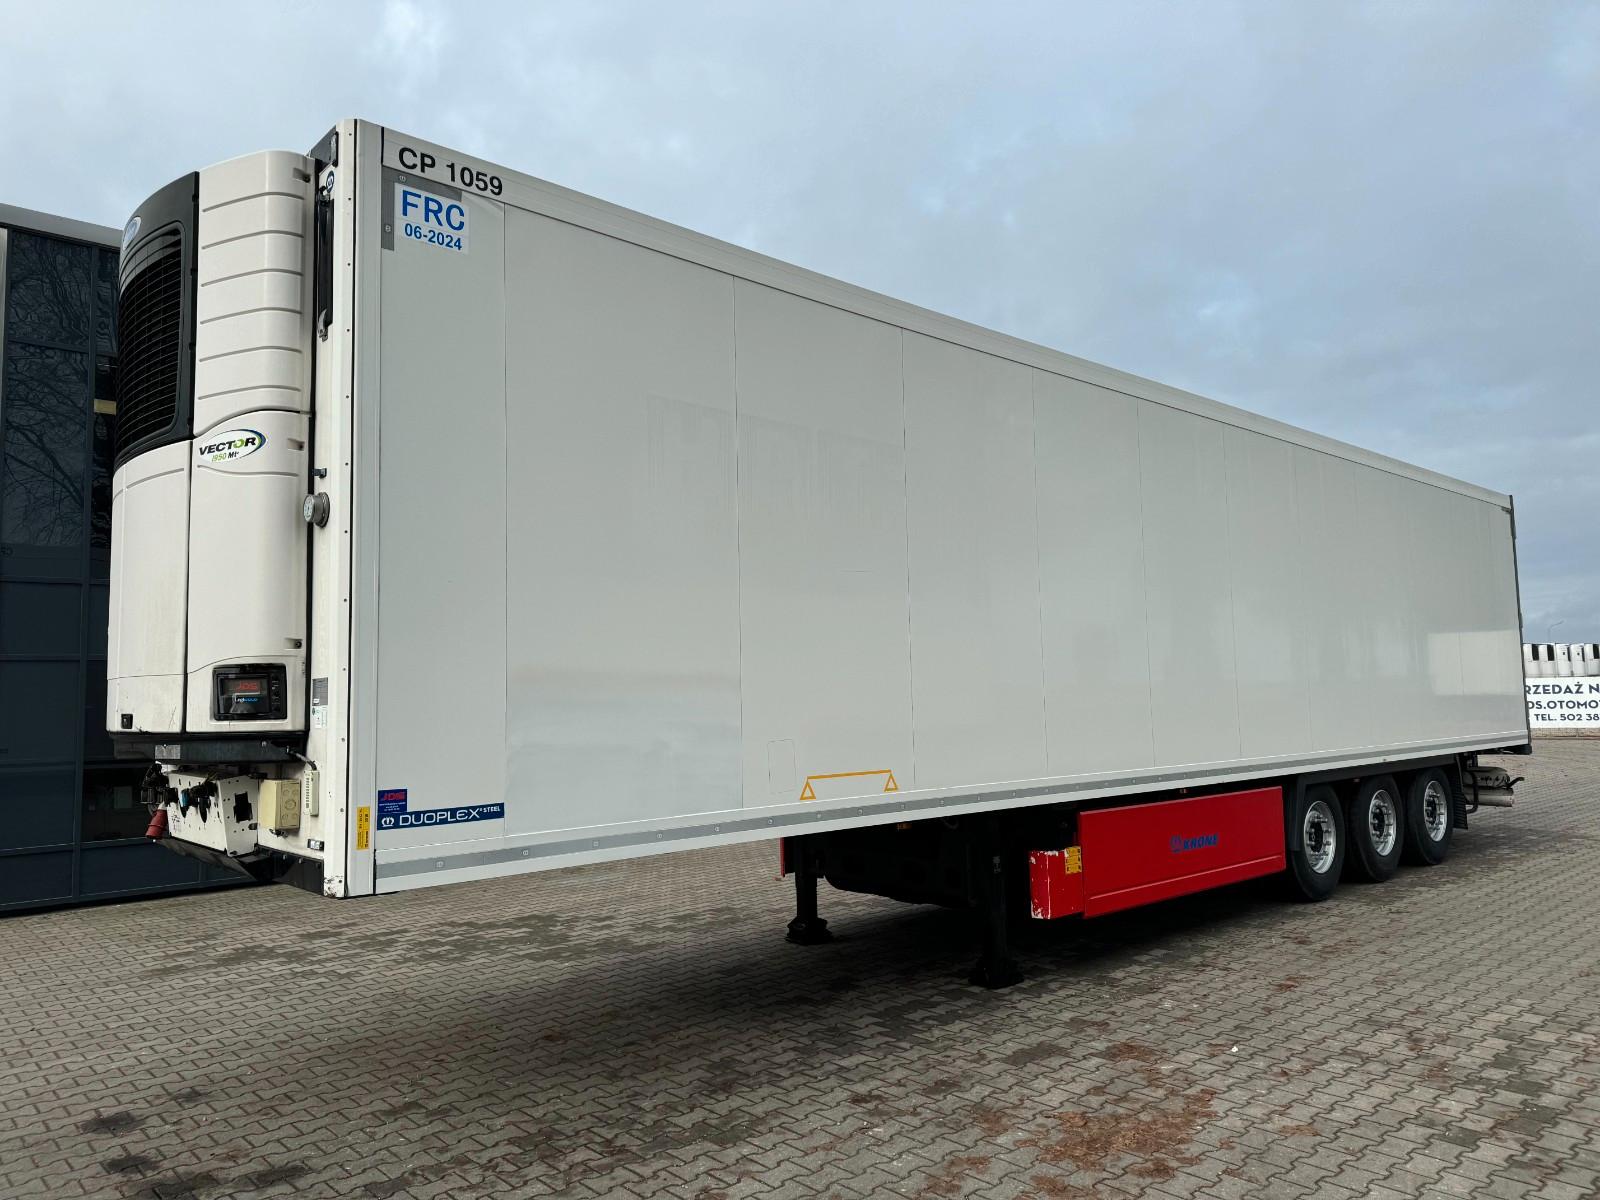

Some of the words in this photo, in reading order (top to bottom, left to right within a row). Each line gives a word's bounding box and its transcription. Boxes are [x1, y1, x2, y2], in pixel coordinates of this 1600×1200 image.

[398, 147, 436, 173] CP
[446, 162, 503, 196] 1059
[402, 190, 465, 231] FRC
[404, 223, 462, 250] 06-2024
[199, 437, 257, 456] VECTOR
[1527, 700, 1600, 710] OS.OTOMO
[1534, 713, 1557, 721] TEL.
[1560, 713, 1583, 721] 502
[399, 808, 480, 826] DUOPLEX
